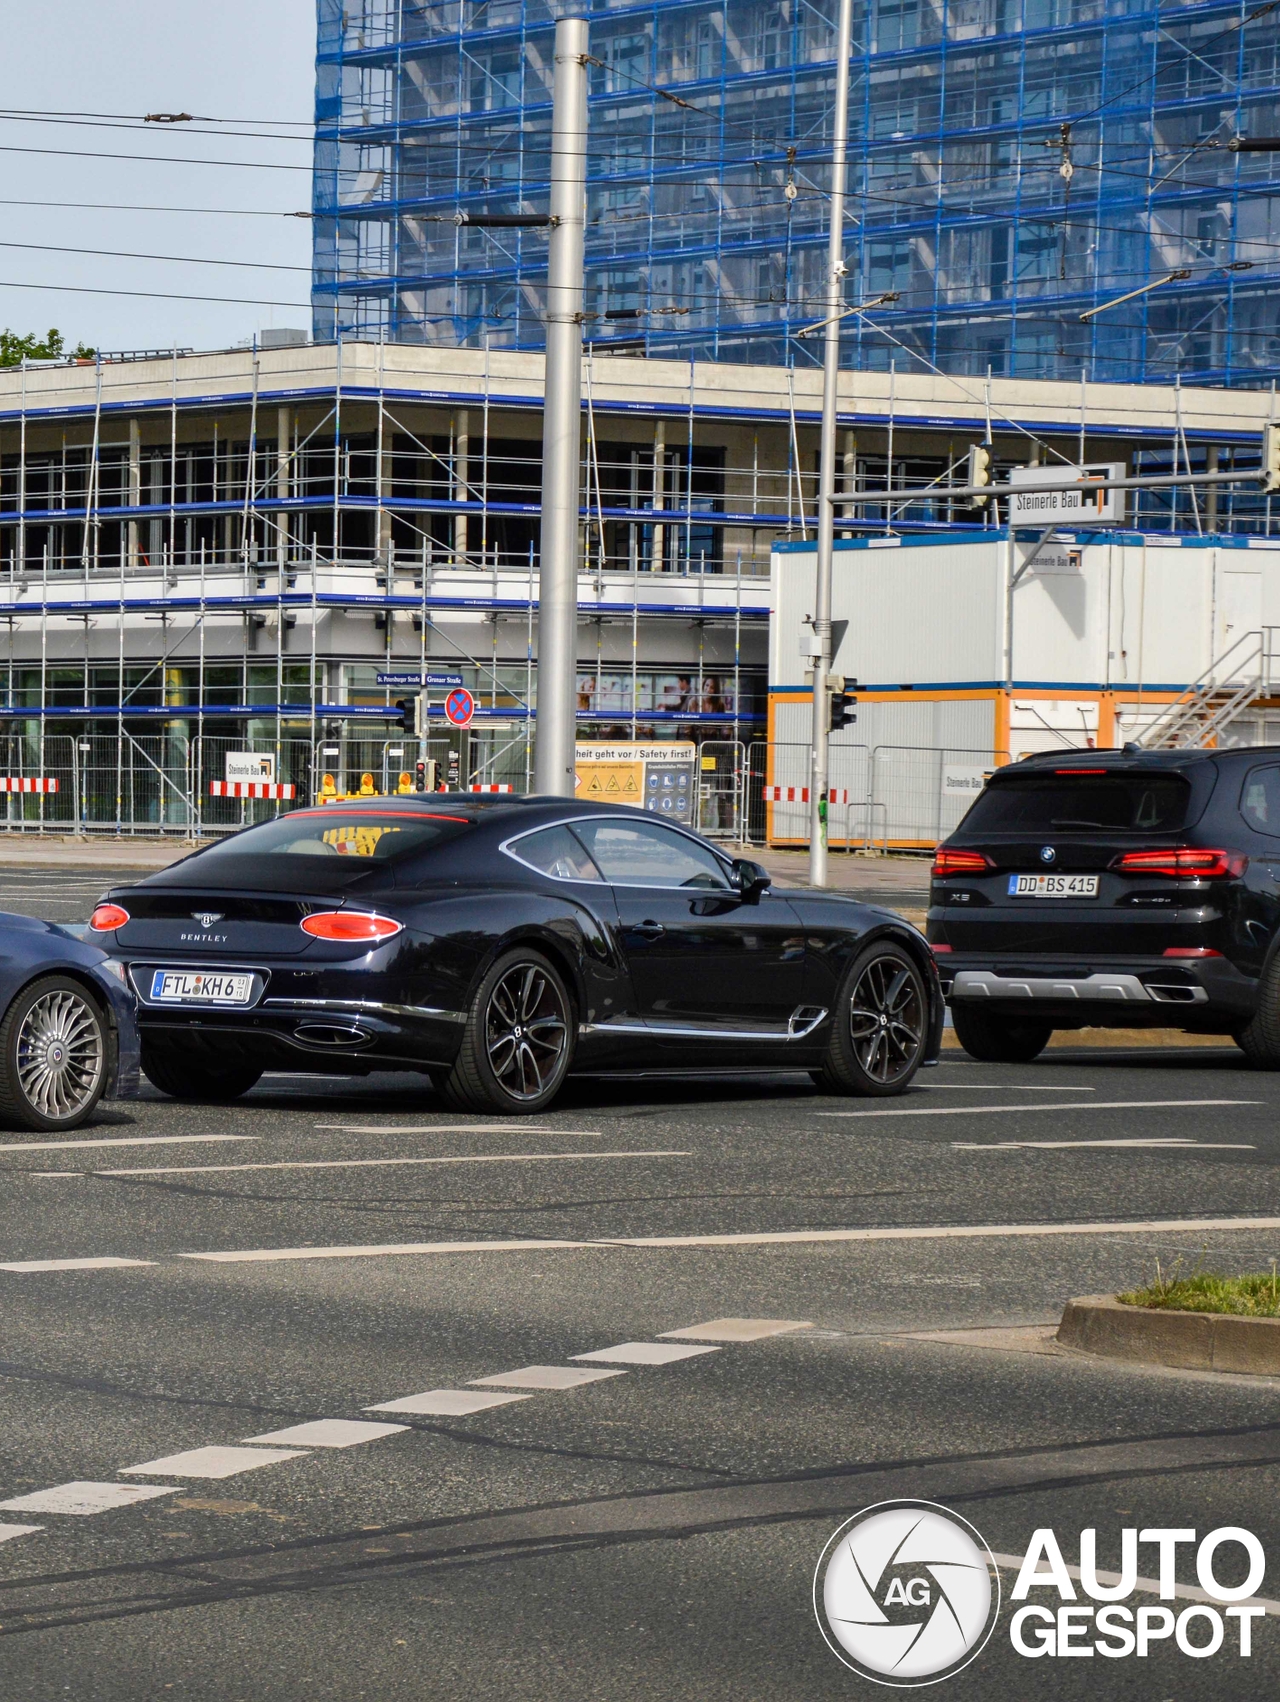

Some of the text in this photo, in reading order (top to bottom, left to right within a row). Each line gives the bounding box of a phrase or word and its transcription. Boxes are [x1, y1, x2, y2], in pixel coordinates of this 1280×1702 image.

[1017, 491, 1079, 510] Steinerle Bau
[1057, 556, 1067, 566] Bau
[595, 750, 615, 759] geht
[639, 750, 668, 759] Safety
[670, 749, 691, 758] first!
[228, 763, 259, 775] Steinerle Bau
[946, 776, 981, 788] Steinerle Bau
[1018, 877, 1096, 892] DD BS 415
[181, 933, 228, 942] BENTLEY
[162, 976, 234, 996] FTL KH 6
